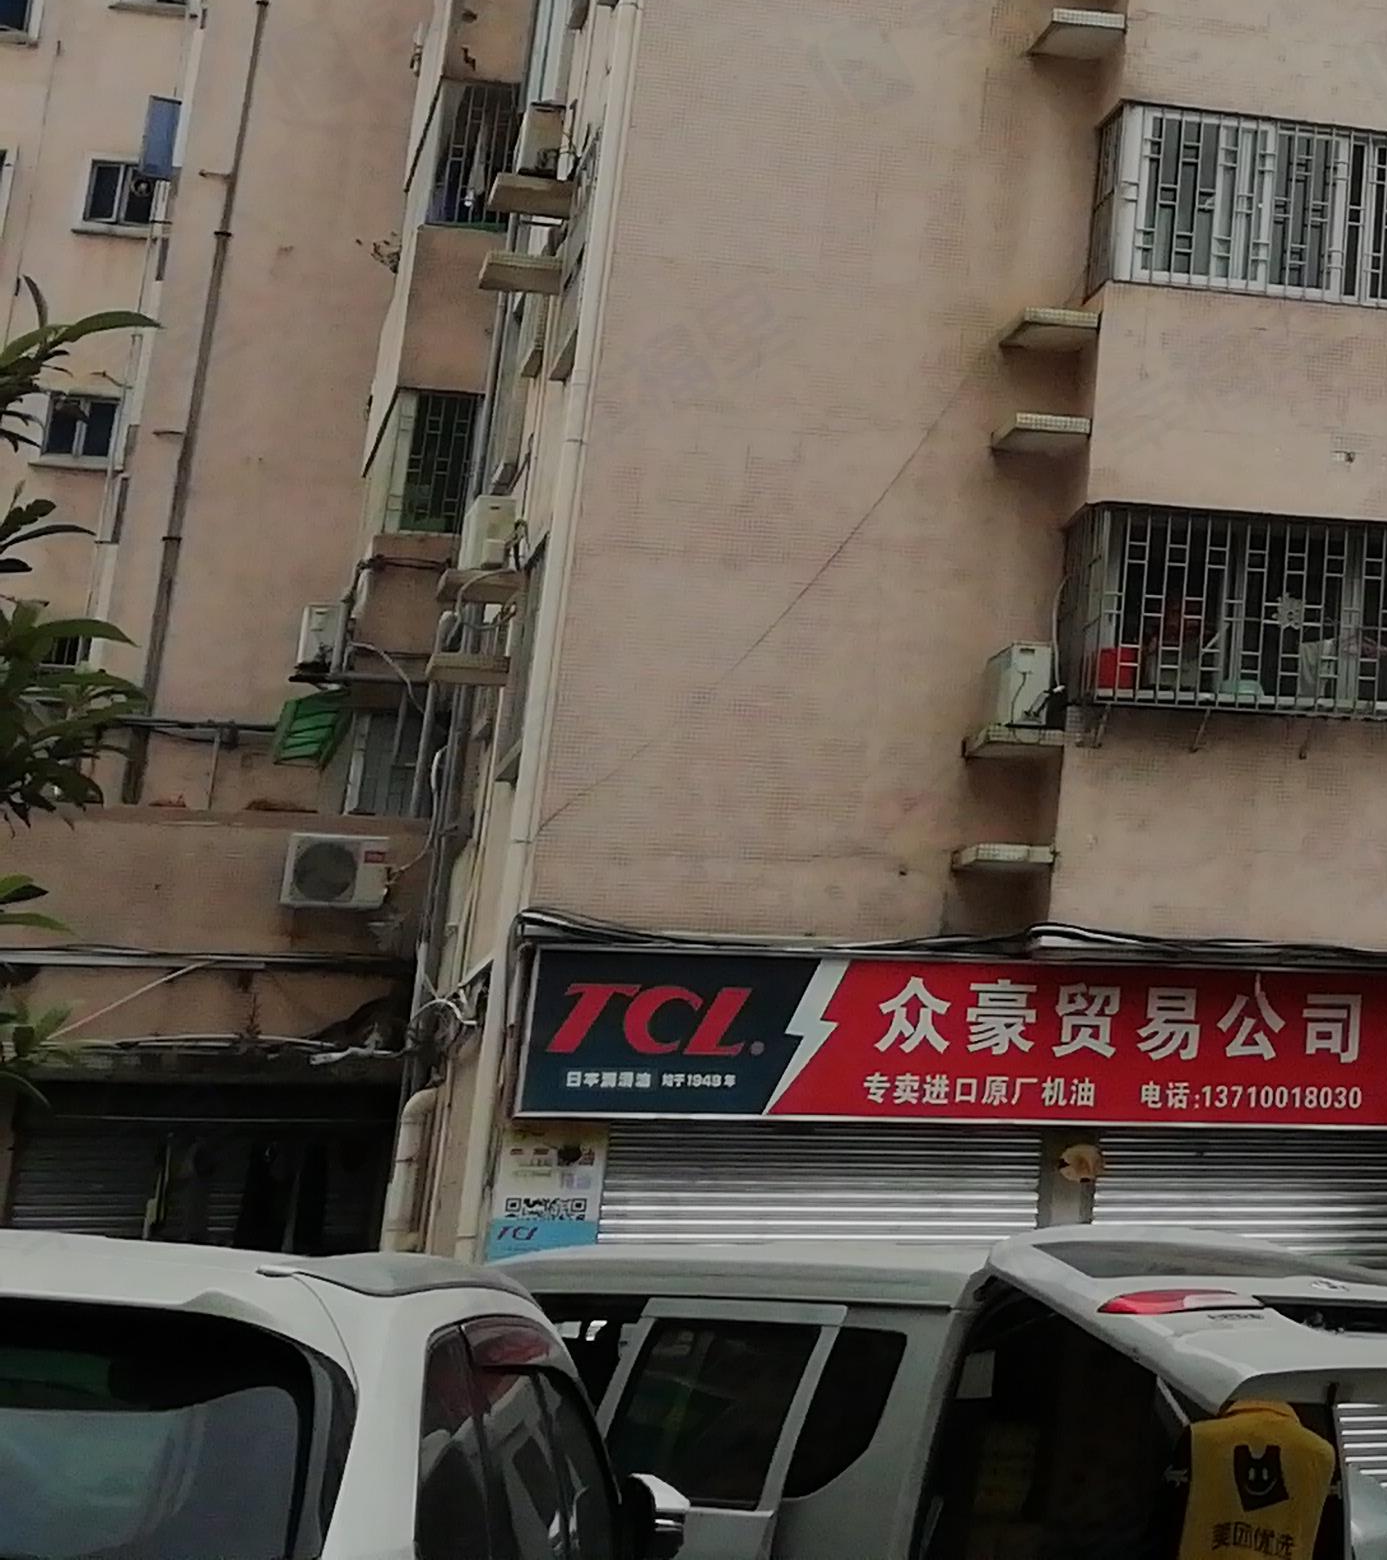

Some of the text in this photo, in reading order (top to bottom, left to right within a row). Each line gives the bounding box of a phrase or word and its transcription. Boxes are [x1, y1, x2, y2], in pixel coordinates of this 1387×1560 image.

[874, 975, 1365, 1063] 众豪贸易公司
[862, 1073, 1363, 1111] 专卖进口原厂机油 电话:13710018030
